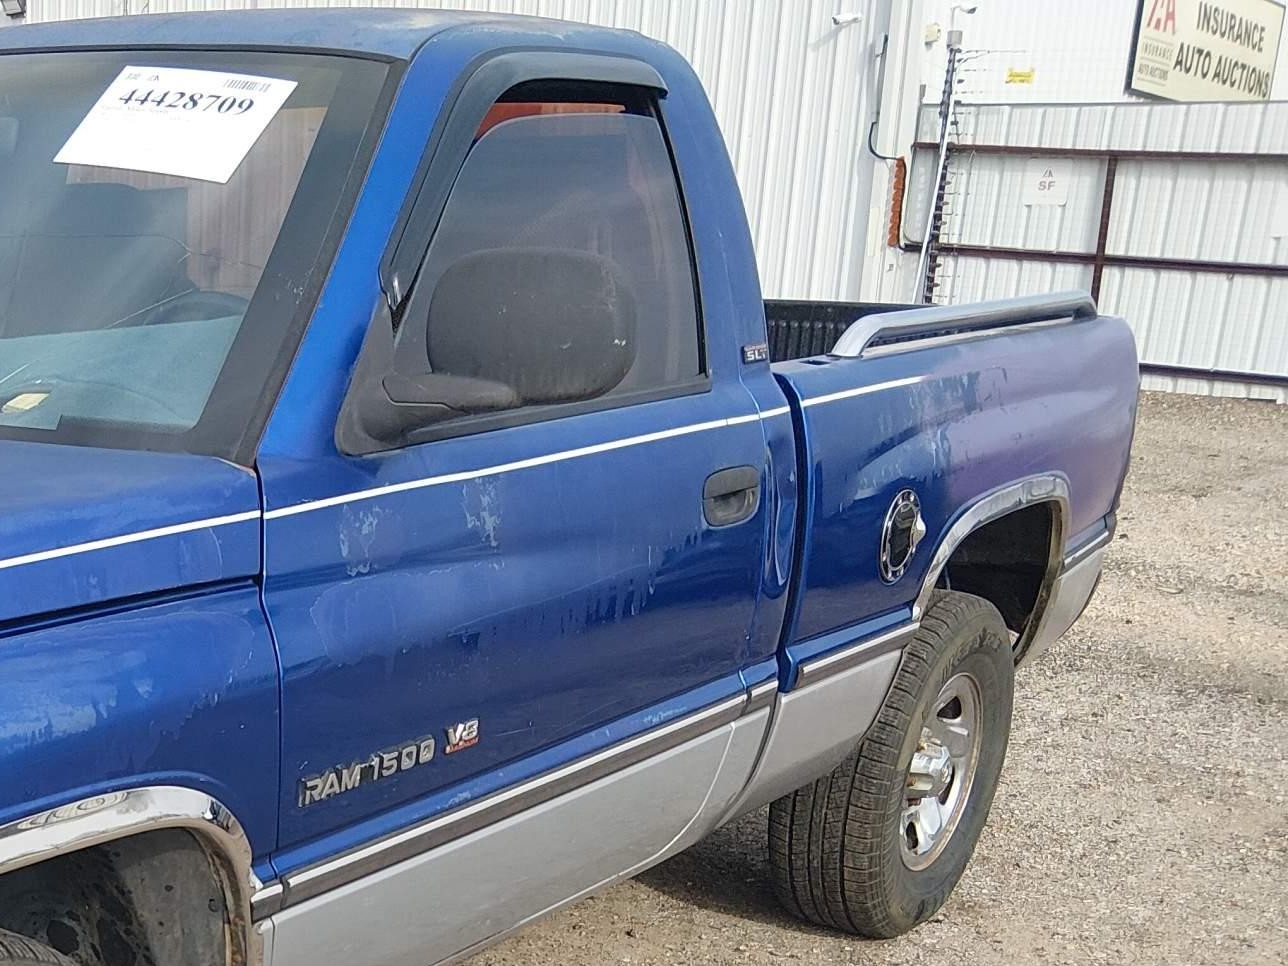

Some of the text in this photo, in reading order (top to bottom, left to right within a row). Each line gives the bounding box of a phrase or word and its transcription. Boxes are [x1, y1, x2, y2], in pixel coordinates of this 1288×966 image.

[1196, 1, 1266, 53] INSURANCE
[1142, 42, 1173, 62] INSURANCE
[1173, 42, 1270, 99] AUTO AUCTIONS
[119, 88, 255, 115] 44428709
[1038, 180, 1056, 192] SF
[298, 719, 479, 808] RAM 1500 V8
